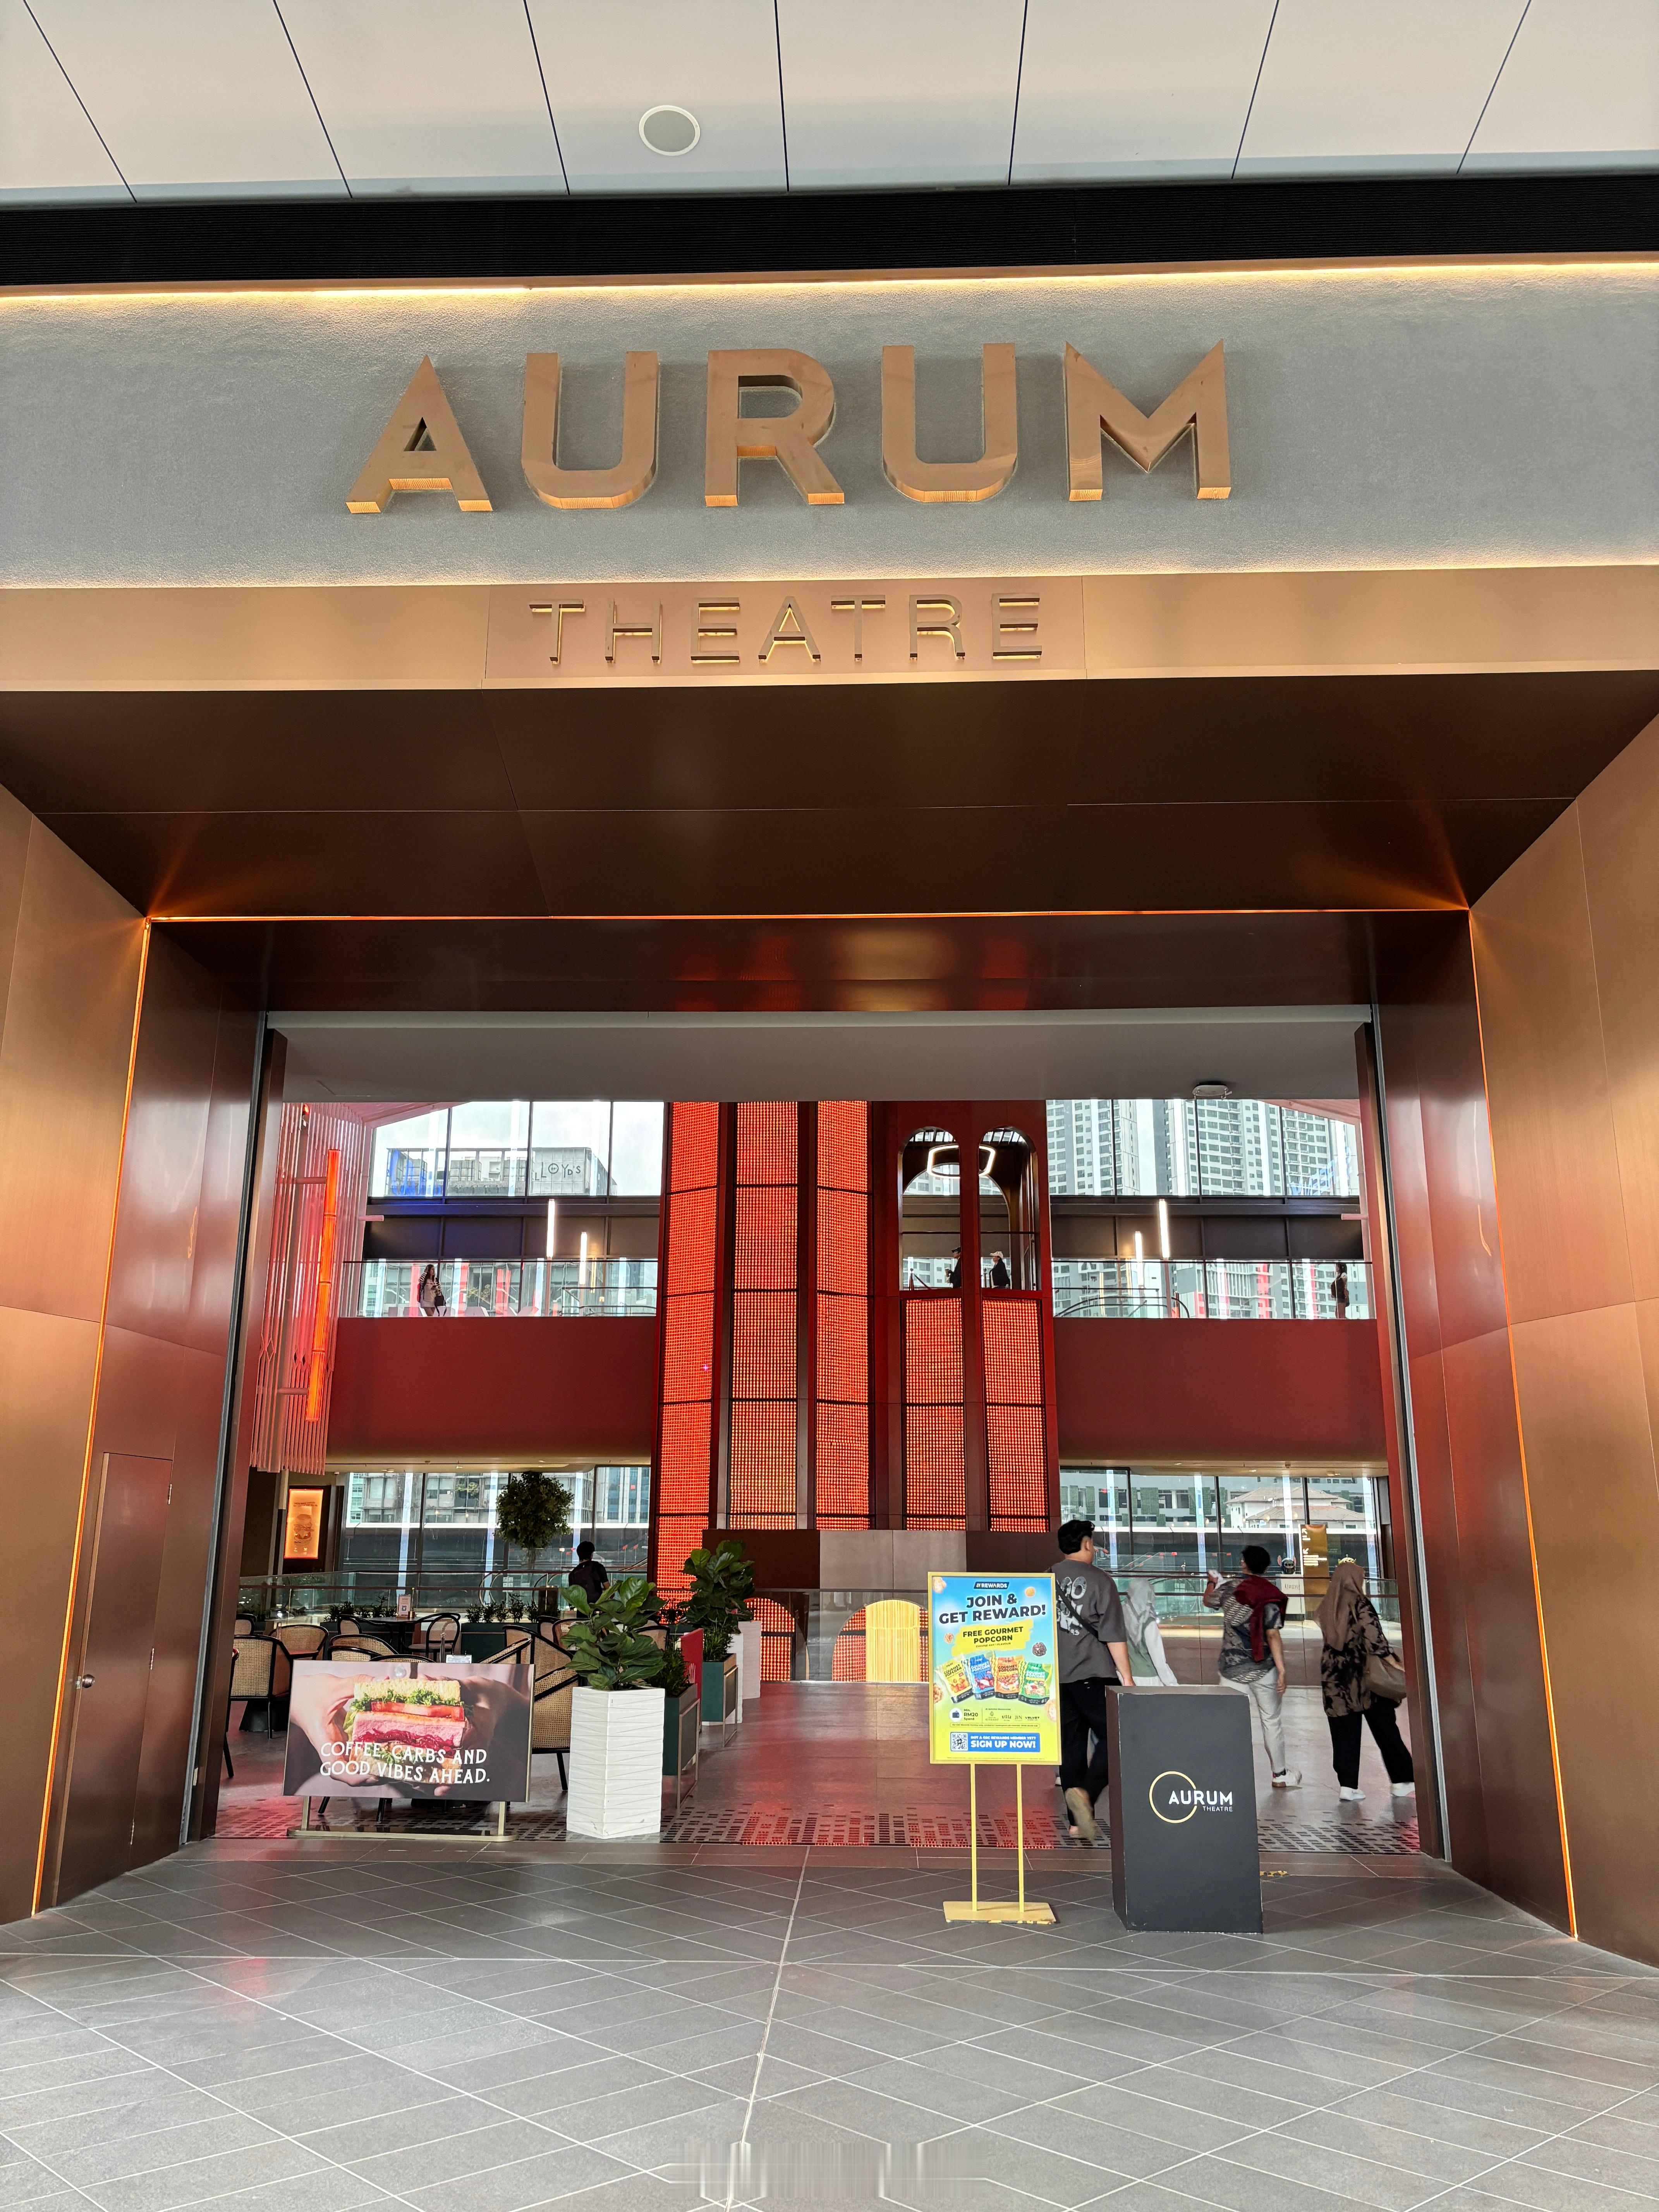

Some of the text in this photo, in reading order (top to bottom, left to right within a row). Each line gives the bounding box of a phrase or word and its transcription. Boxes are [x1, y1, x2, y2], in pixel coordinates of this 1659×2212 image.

[345, 338, 1232, 514] AURUM
[529, 592, 1043, 665] THEATRE
[966, 1593, 1017, 1608] JOIN &
[939, 1604, 1046, 1624] GET REWARD!
[974, 1635, 1013, 1644] POPCORN
[984, 1626, 1024, 1635] GOURMET
[320, 1741, 487, 1764] COFFEE, CARBS AND
[320, 1760, 490, 1784] GOOD VIBES AHEAD.
[1169, 1790, 1233, 1805] AURUM
